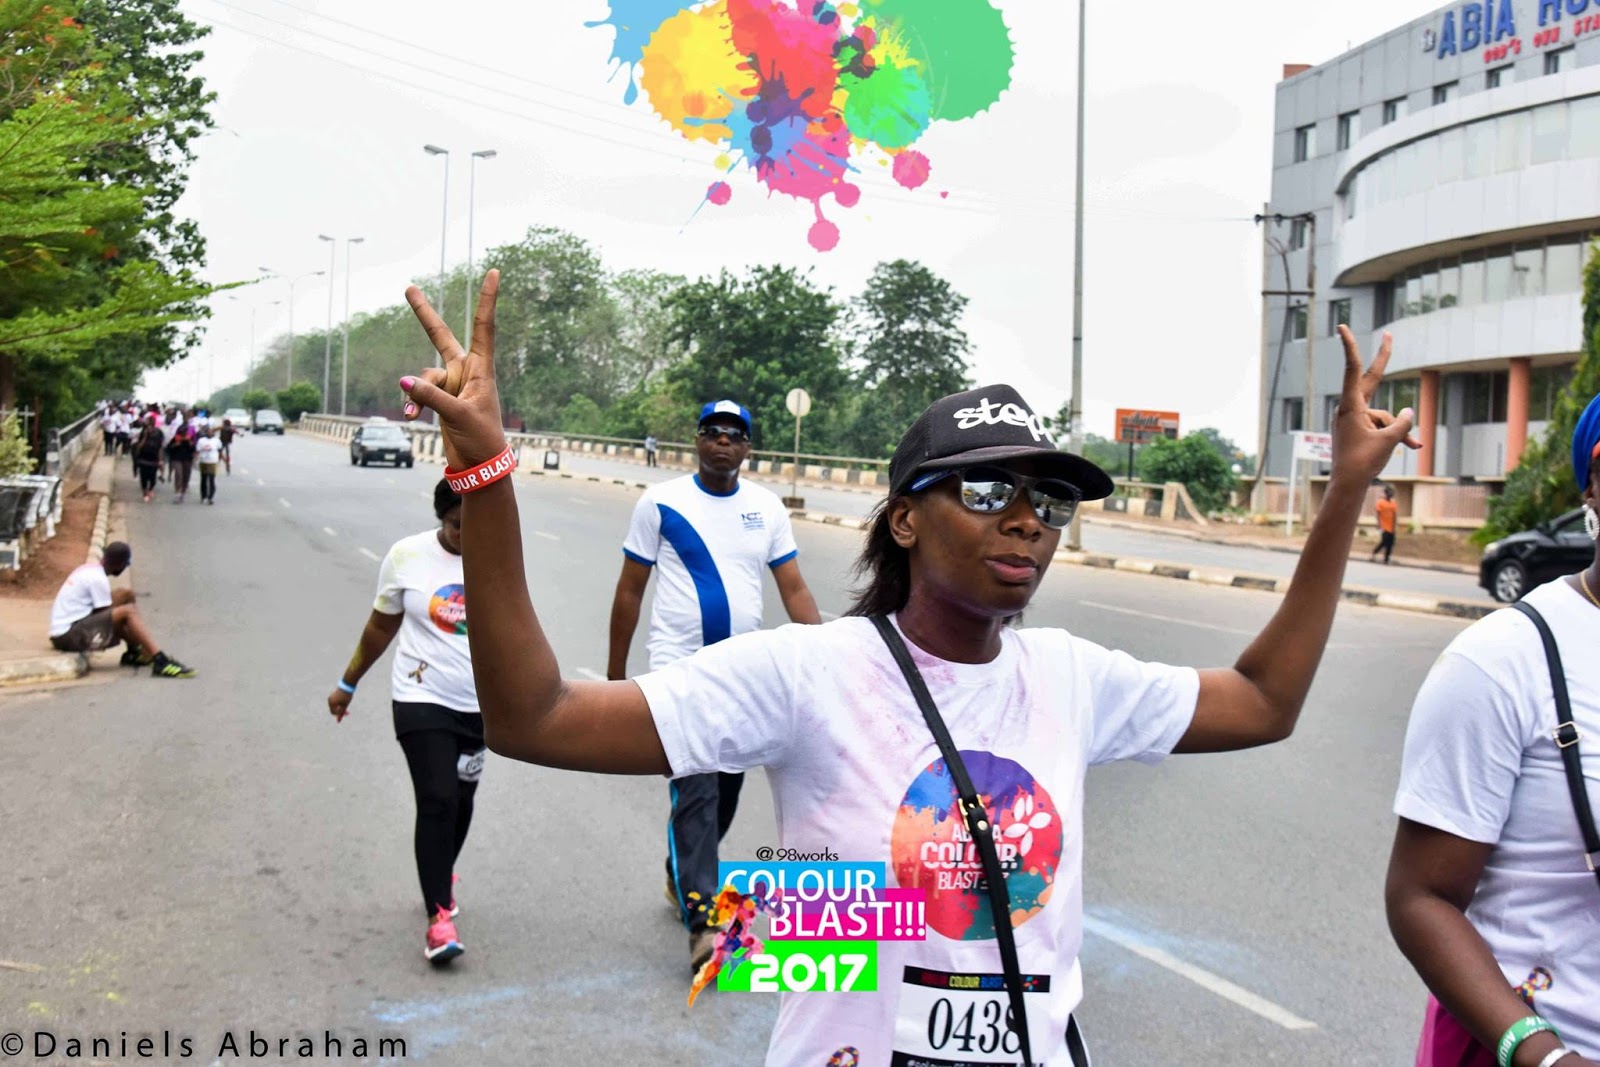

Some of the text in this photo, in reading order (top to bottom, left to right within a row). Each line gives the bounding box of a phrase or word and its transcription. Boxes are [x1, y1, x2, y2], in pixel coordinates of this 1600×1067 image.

[1438, 0, 1515, 59] ABIA
[479, 453, 513, 481] BLAST
[952, 823, 1003, 842] ABA
